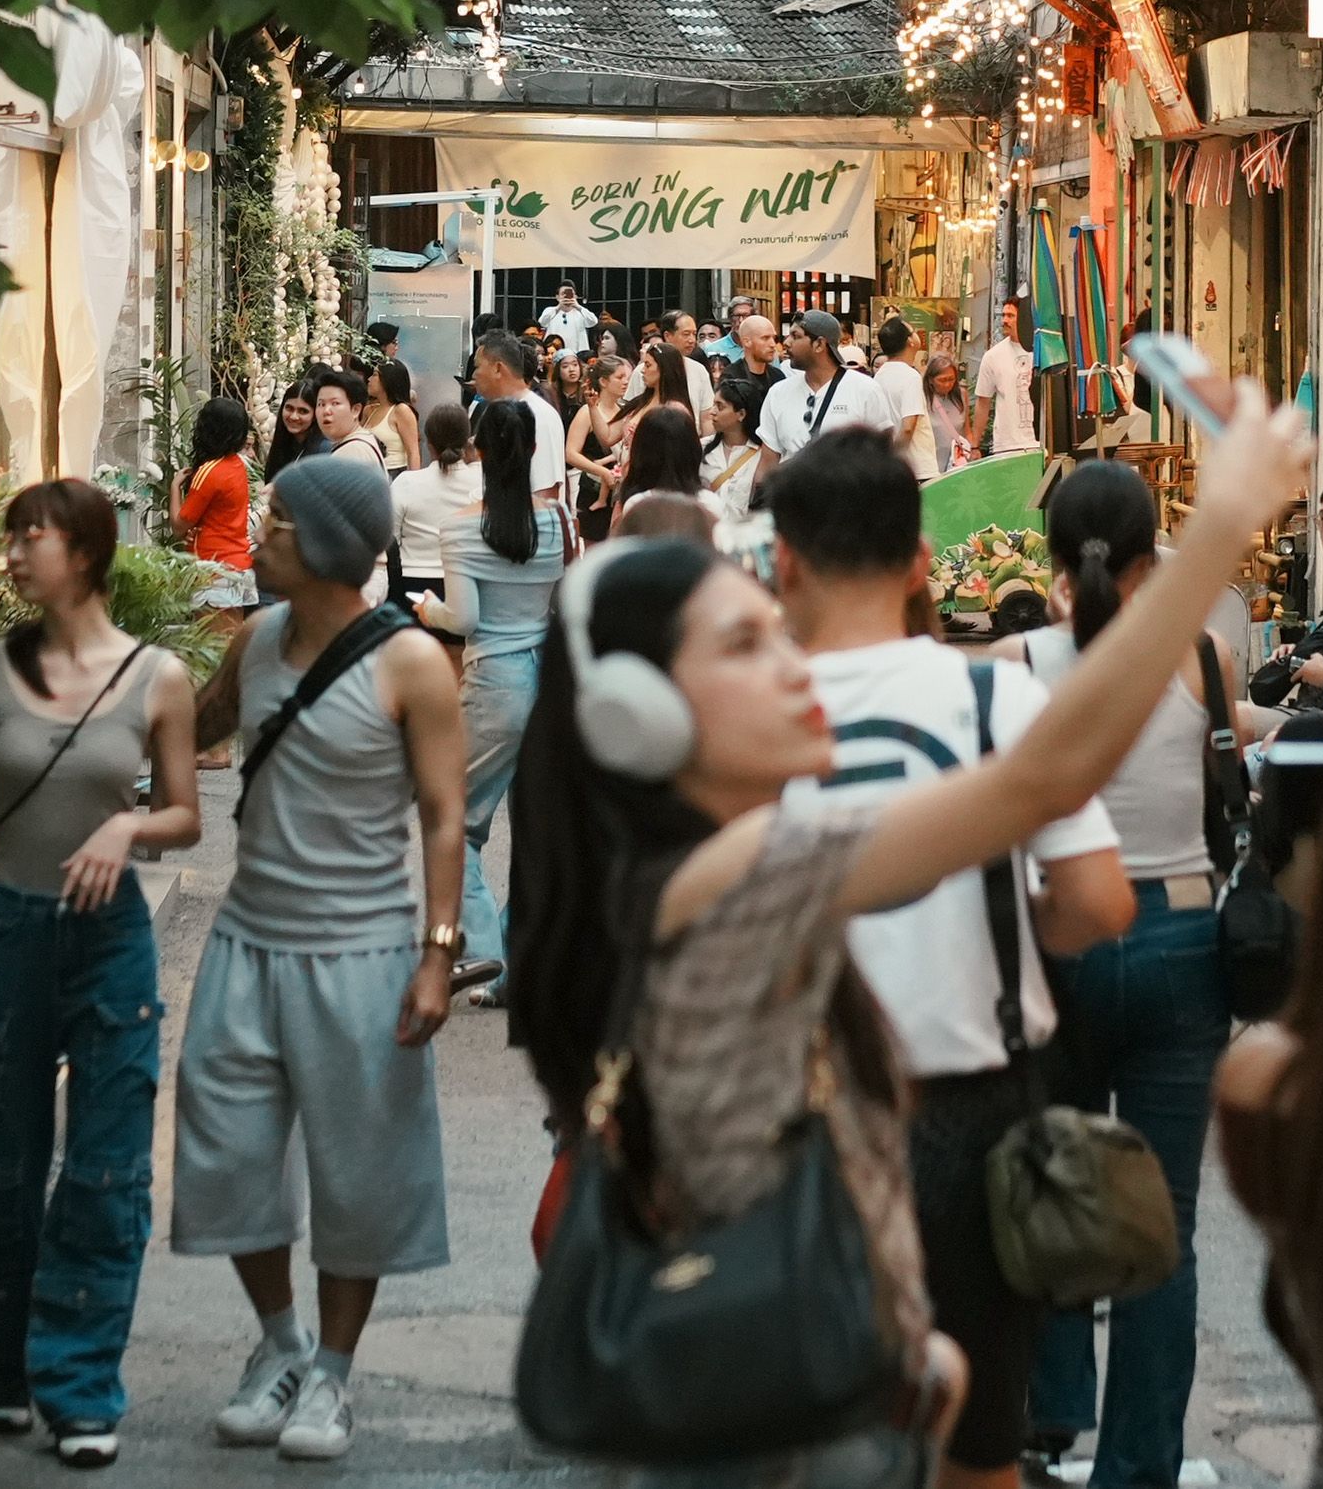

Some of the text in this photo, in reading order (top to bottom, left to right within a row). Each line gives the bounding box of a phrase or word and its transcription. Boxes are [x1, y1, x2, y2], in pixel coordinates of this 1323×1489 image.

[571, 170, 681, 210] BORN IN
[588, 160, 860, 243] SONG WAT
[509, 219, 540, 229] GOOSE
